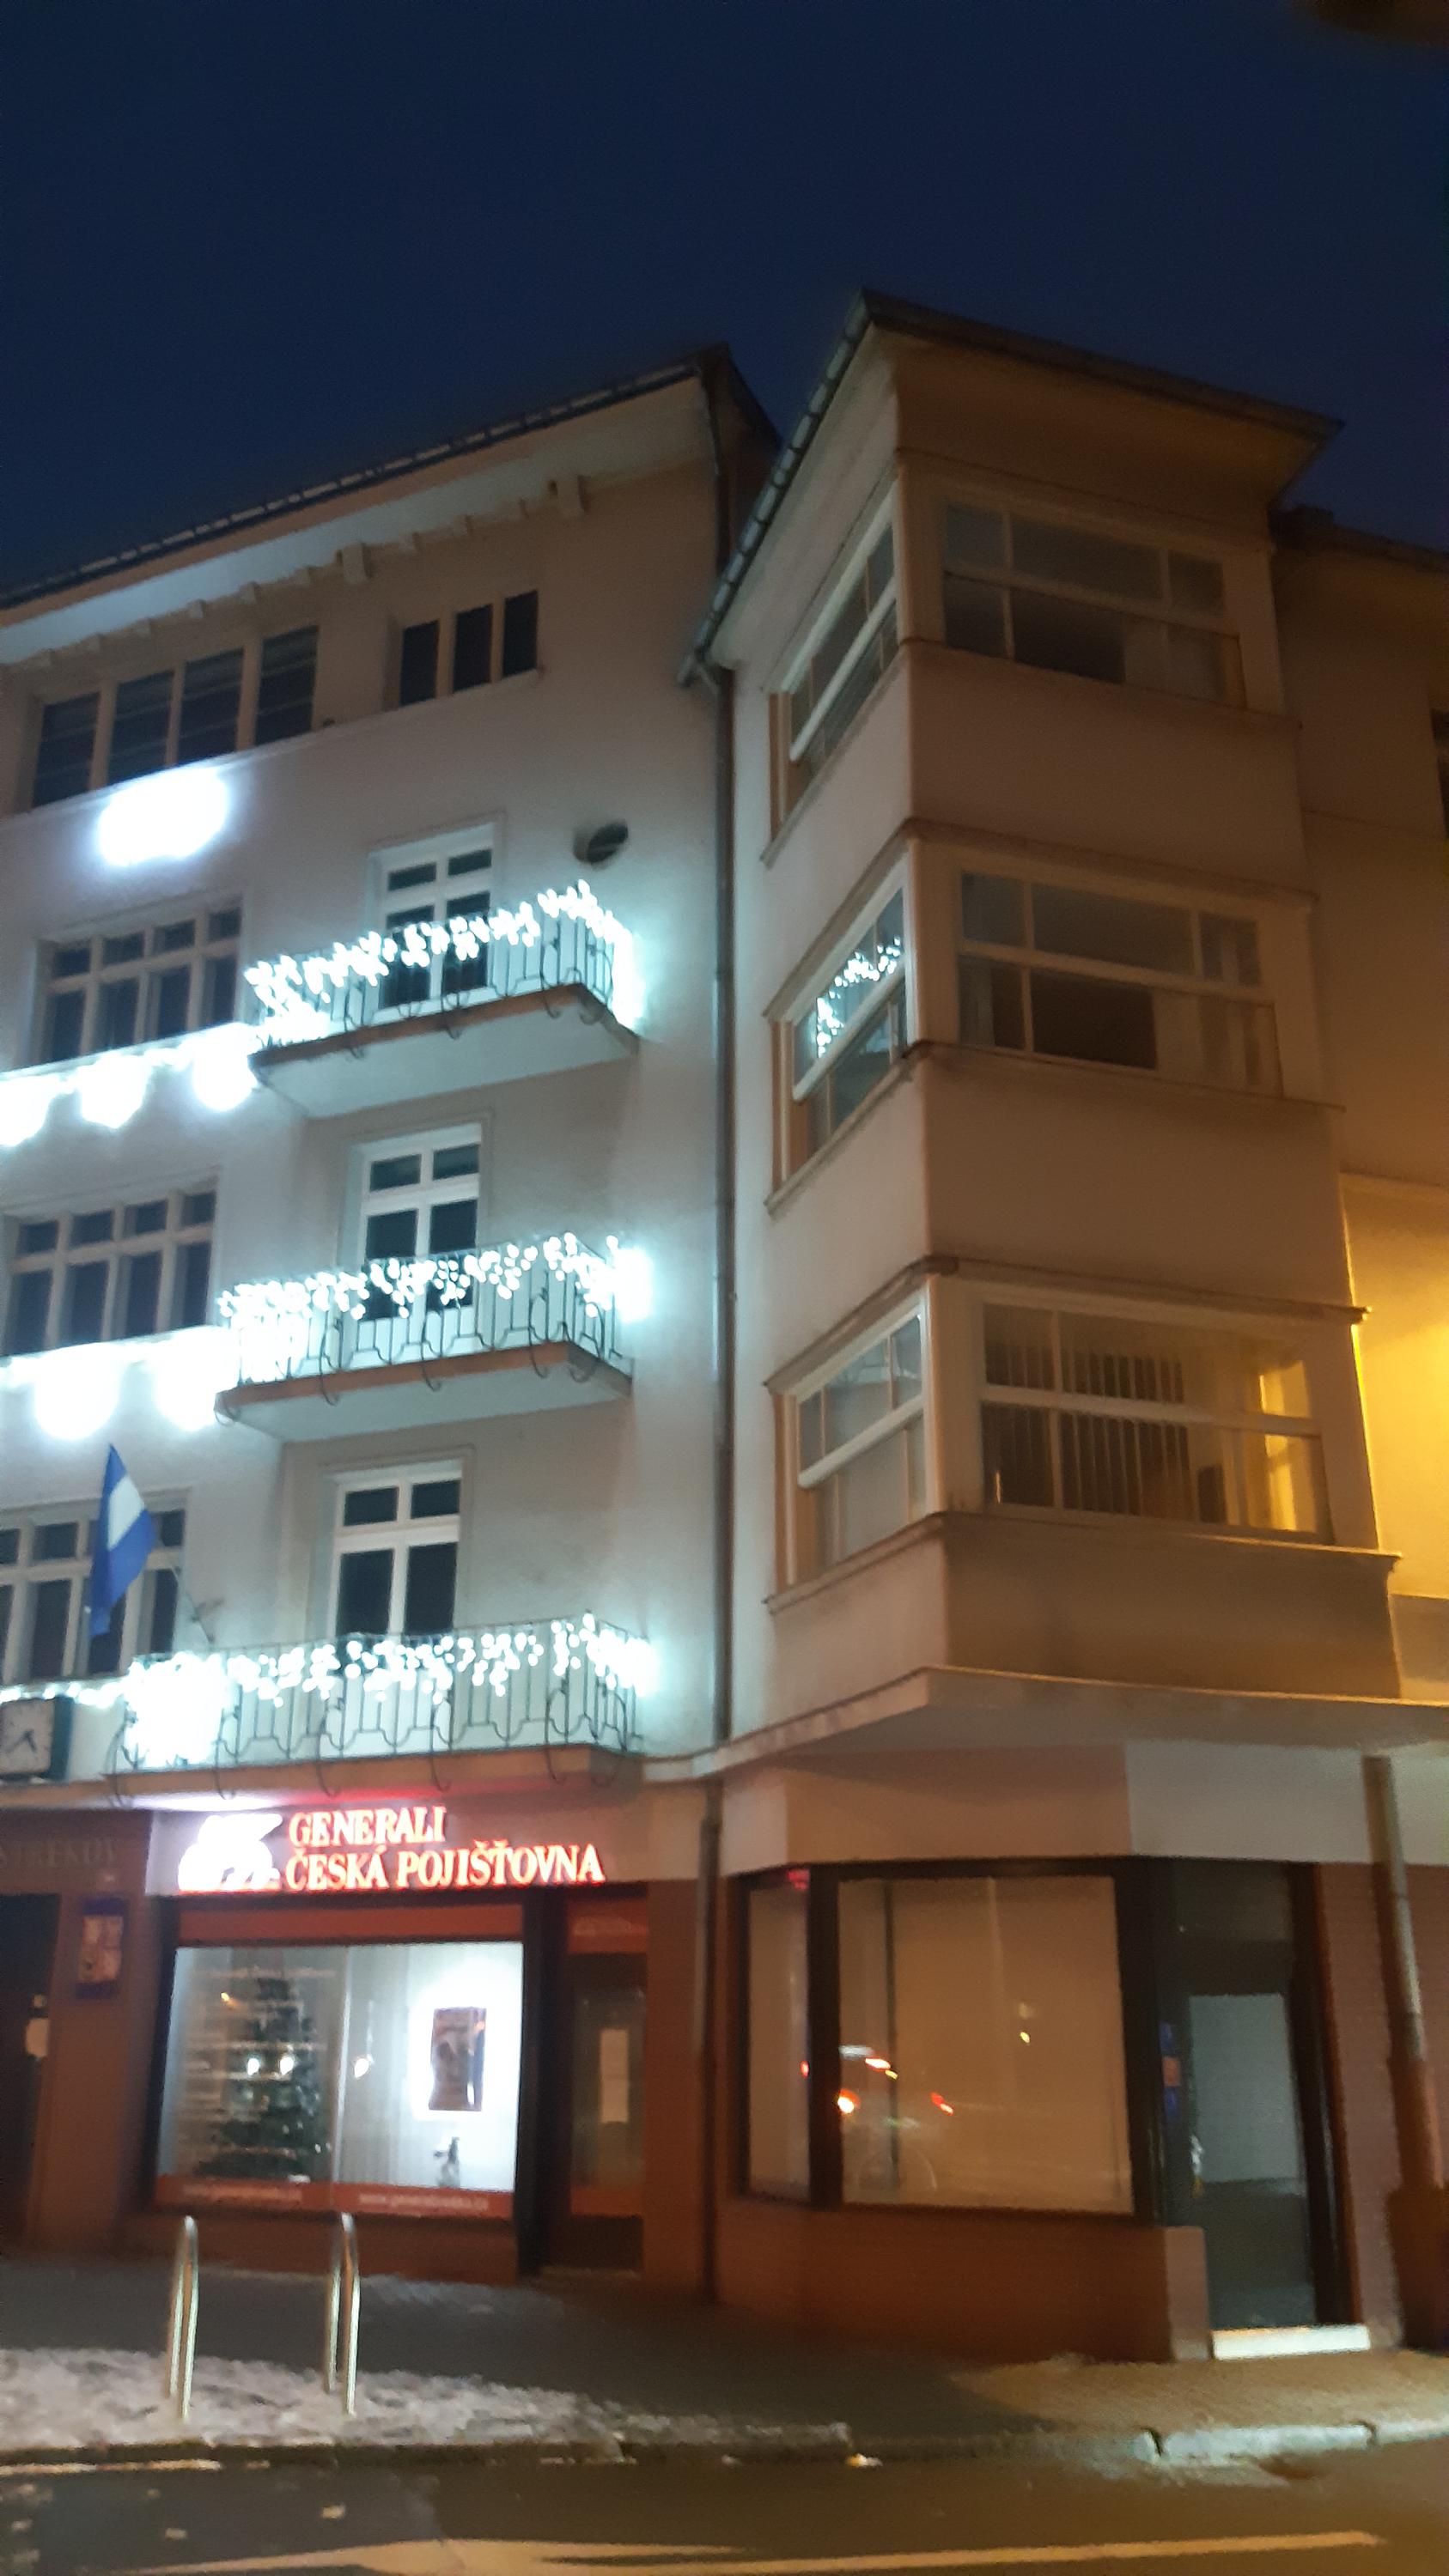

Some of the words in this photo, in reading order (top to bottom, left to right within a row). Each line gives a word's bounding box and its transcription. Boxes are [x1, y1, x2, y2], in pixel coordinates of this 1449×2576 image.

[288, 1806, 446, 1847] GENERALI
[285, 1845, 389, 1891] ČESKÁ
[396, 1839, 606, 1888] POJIŠŤOVNA
